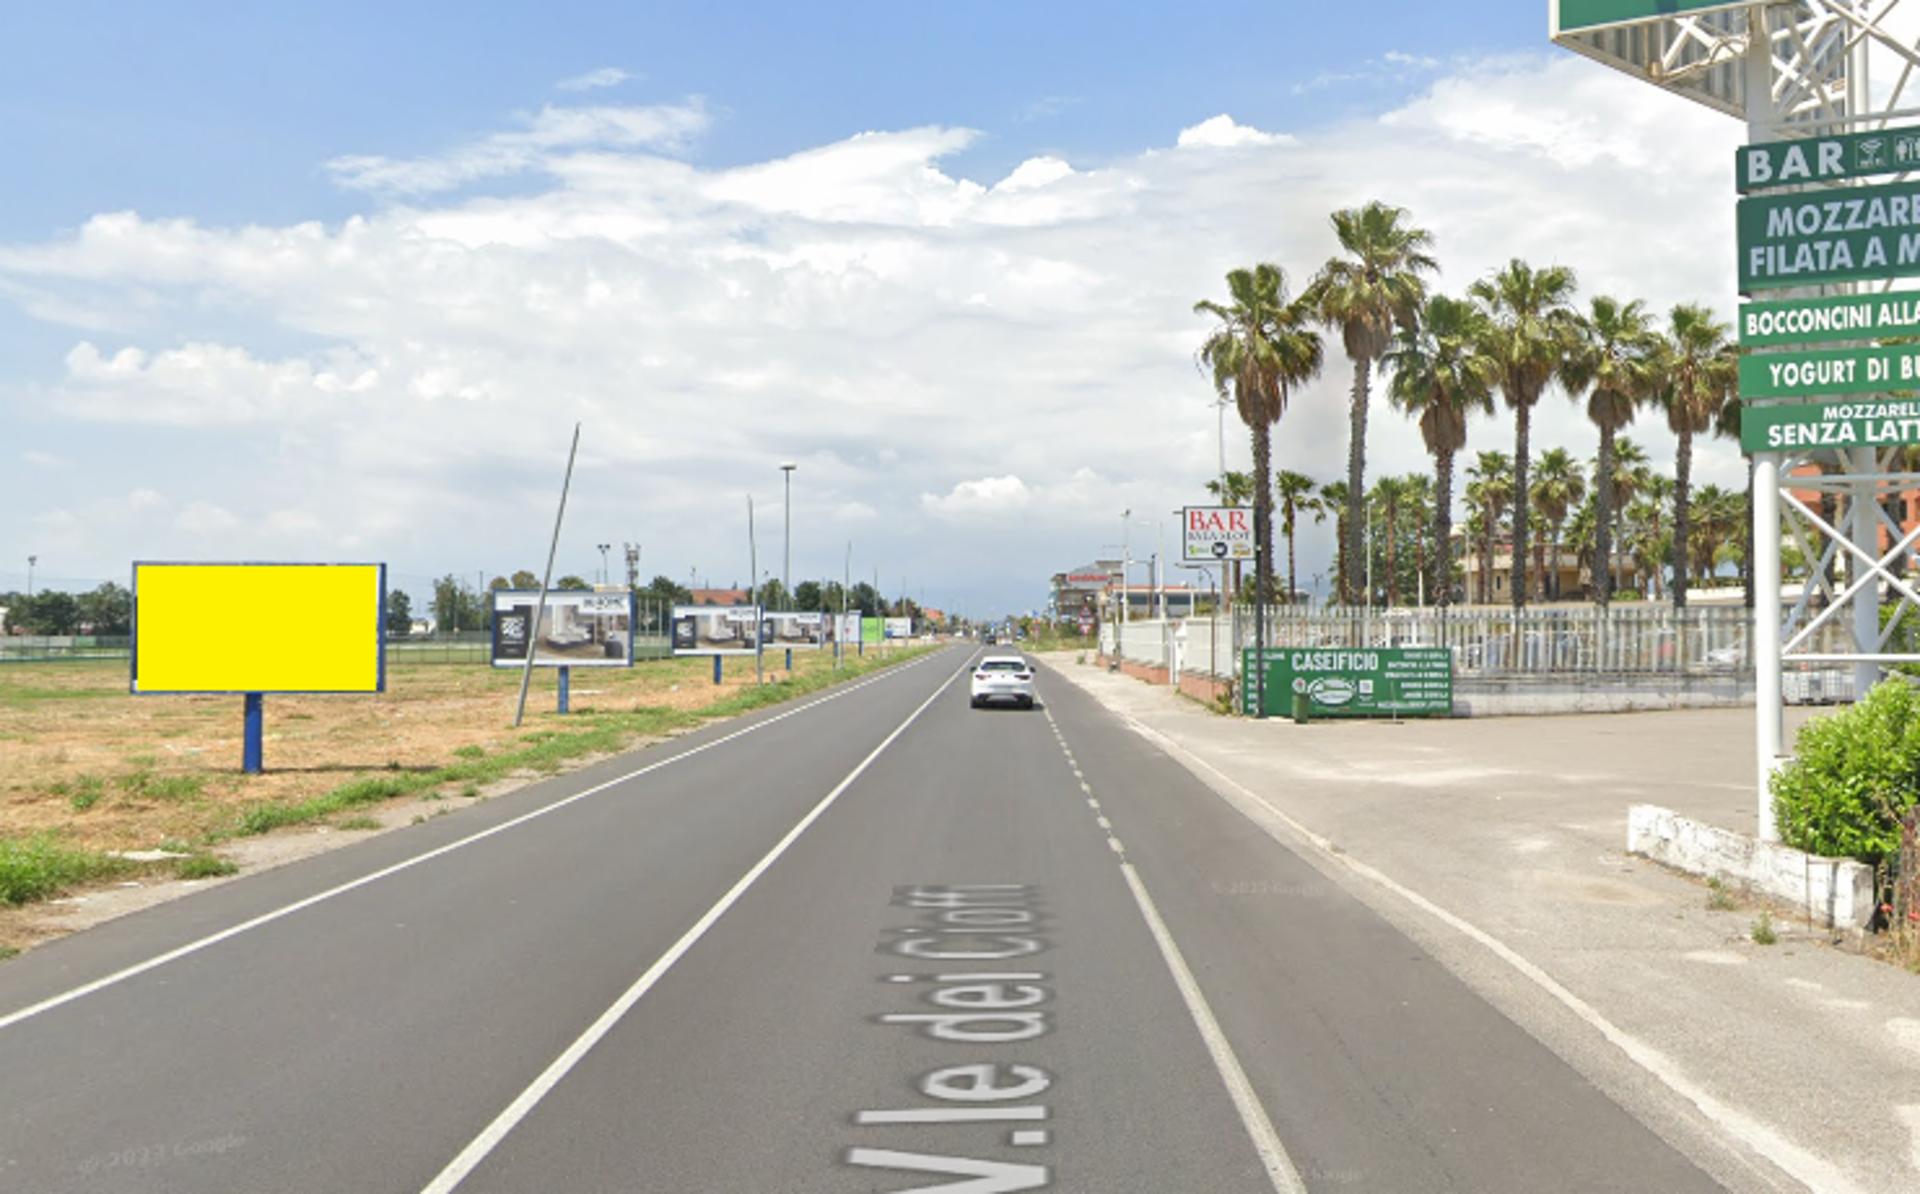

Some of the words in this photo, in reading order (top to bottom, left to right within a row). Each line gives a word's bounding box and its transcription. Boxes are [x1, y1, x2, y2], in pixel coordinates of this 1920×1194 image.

[1748, 141, 1845, 183] BAR
[1750, 239, 1853, 276] FILATA
[1862, 235, 1888, 268] A
[1746, 303, 1871, 336] BOCCONCINI
[1769, 358, 1856, 388] YOGURT
[1867, 357, 1889, 381] DI
[1824, 402, 1920, 420] MOZZAREL
[1768, 422, 1856, 447] SENZA
[1190, 511, 1249, 530] BAR
[1291, 652, 1379, 671] CASEIFICIO
